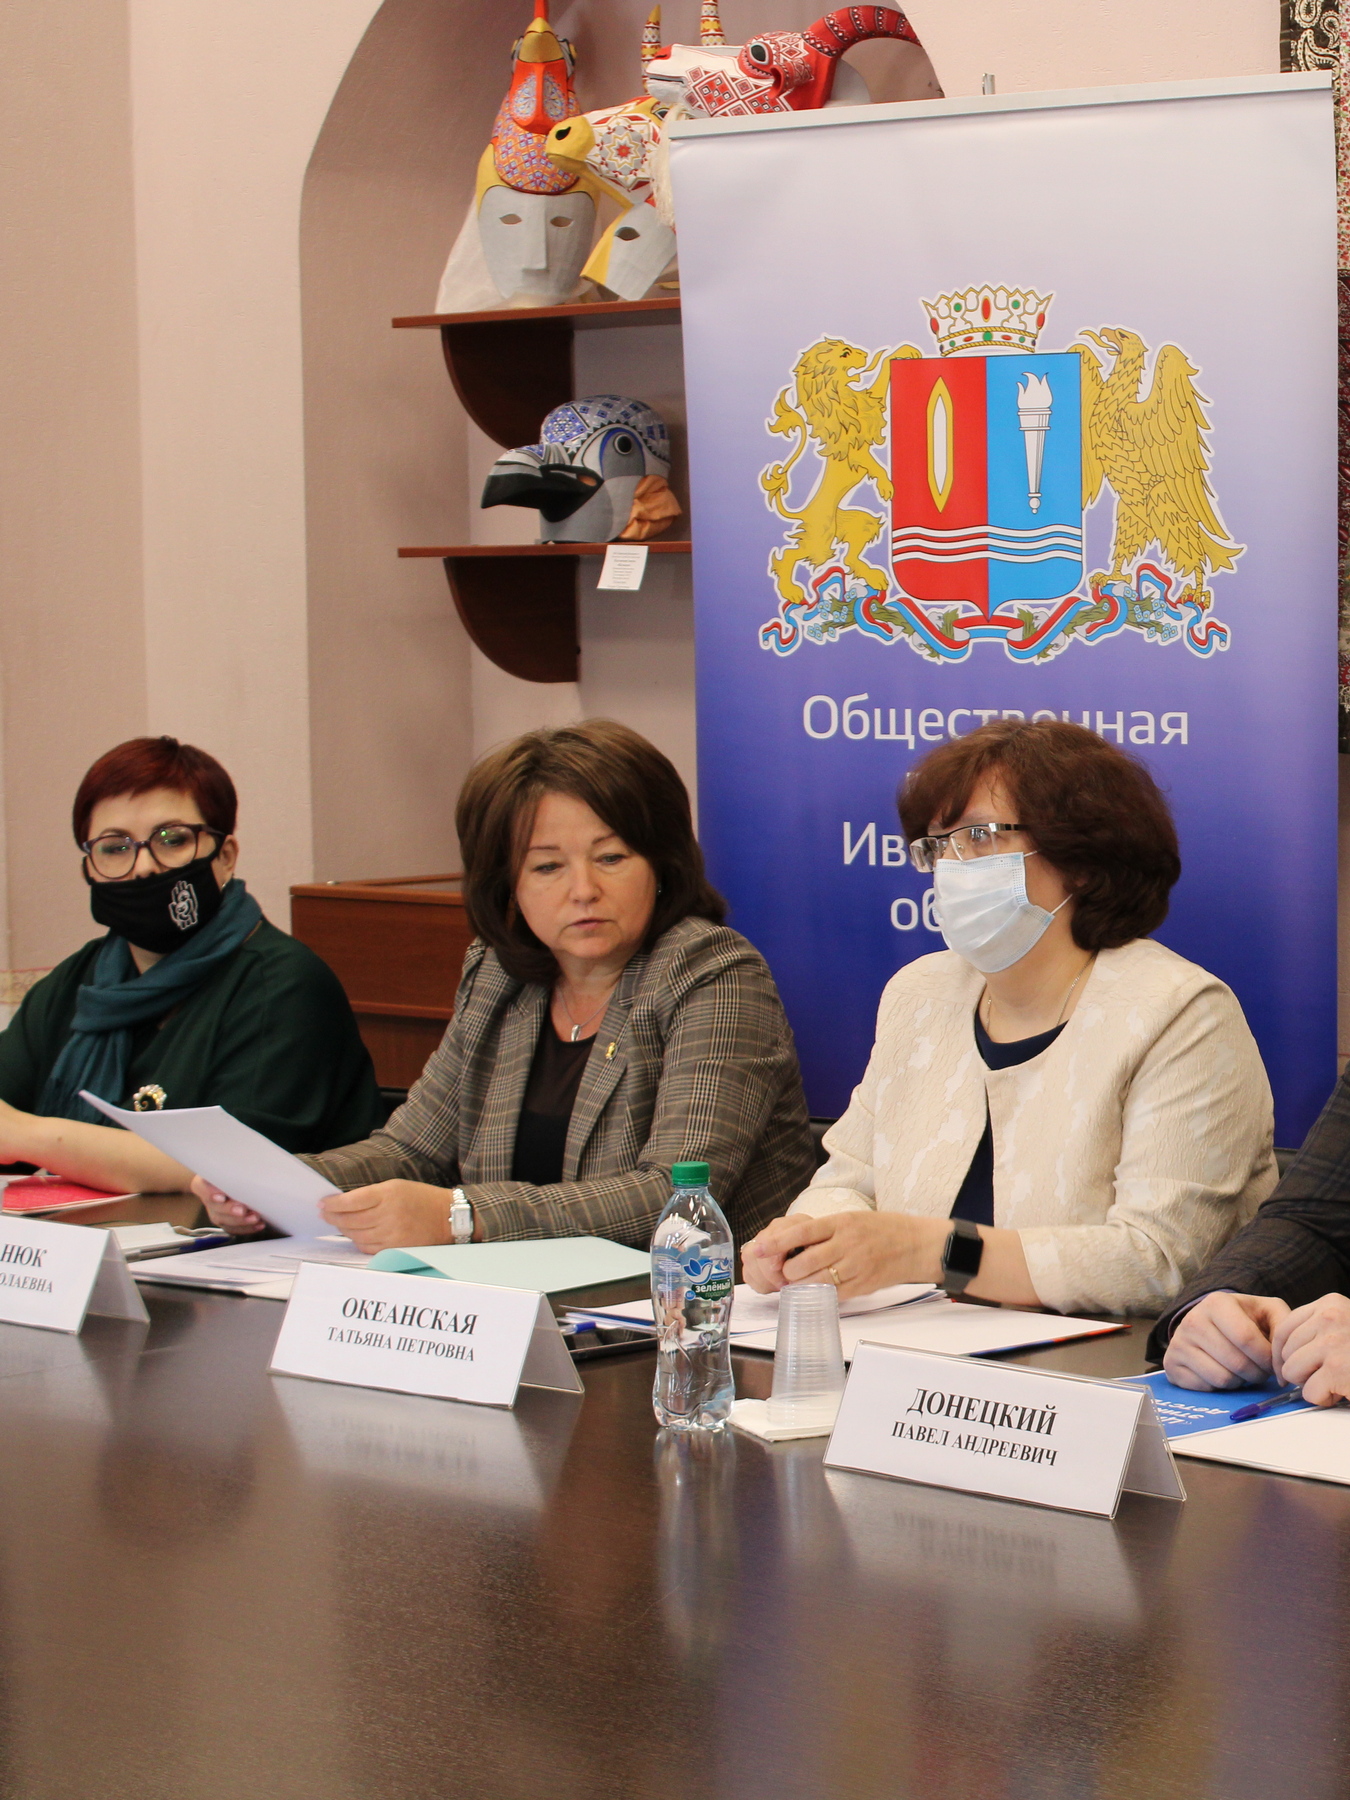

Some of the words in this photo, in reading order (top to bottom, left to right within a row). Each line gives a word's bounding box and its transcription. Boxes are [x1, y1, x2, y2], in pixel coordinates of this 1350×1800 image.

[342, 1297, 479, 1335] ОКЕАНСКАЯ
[327, 1326, 392, 1349] ТАТЬЯНА
[396, 1336, 475, 1361] ПЕТРОВНА
[906, 1388, 1059, 1436] ДОНЕЦКИЙ
[891, 1421, 950, 1446] ПАВЕЛ
[951, 1433, 1059, 1466] АНДРЕЕВИЧ
